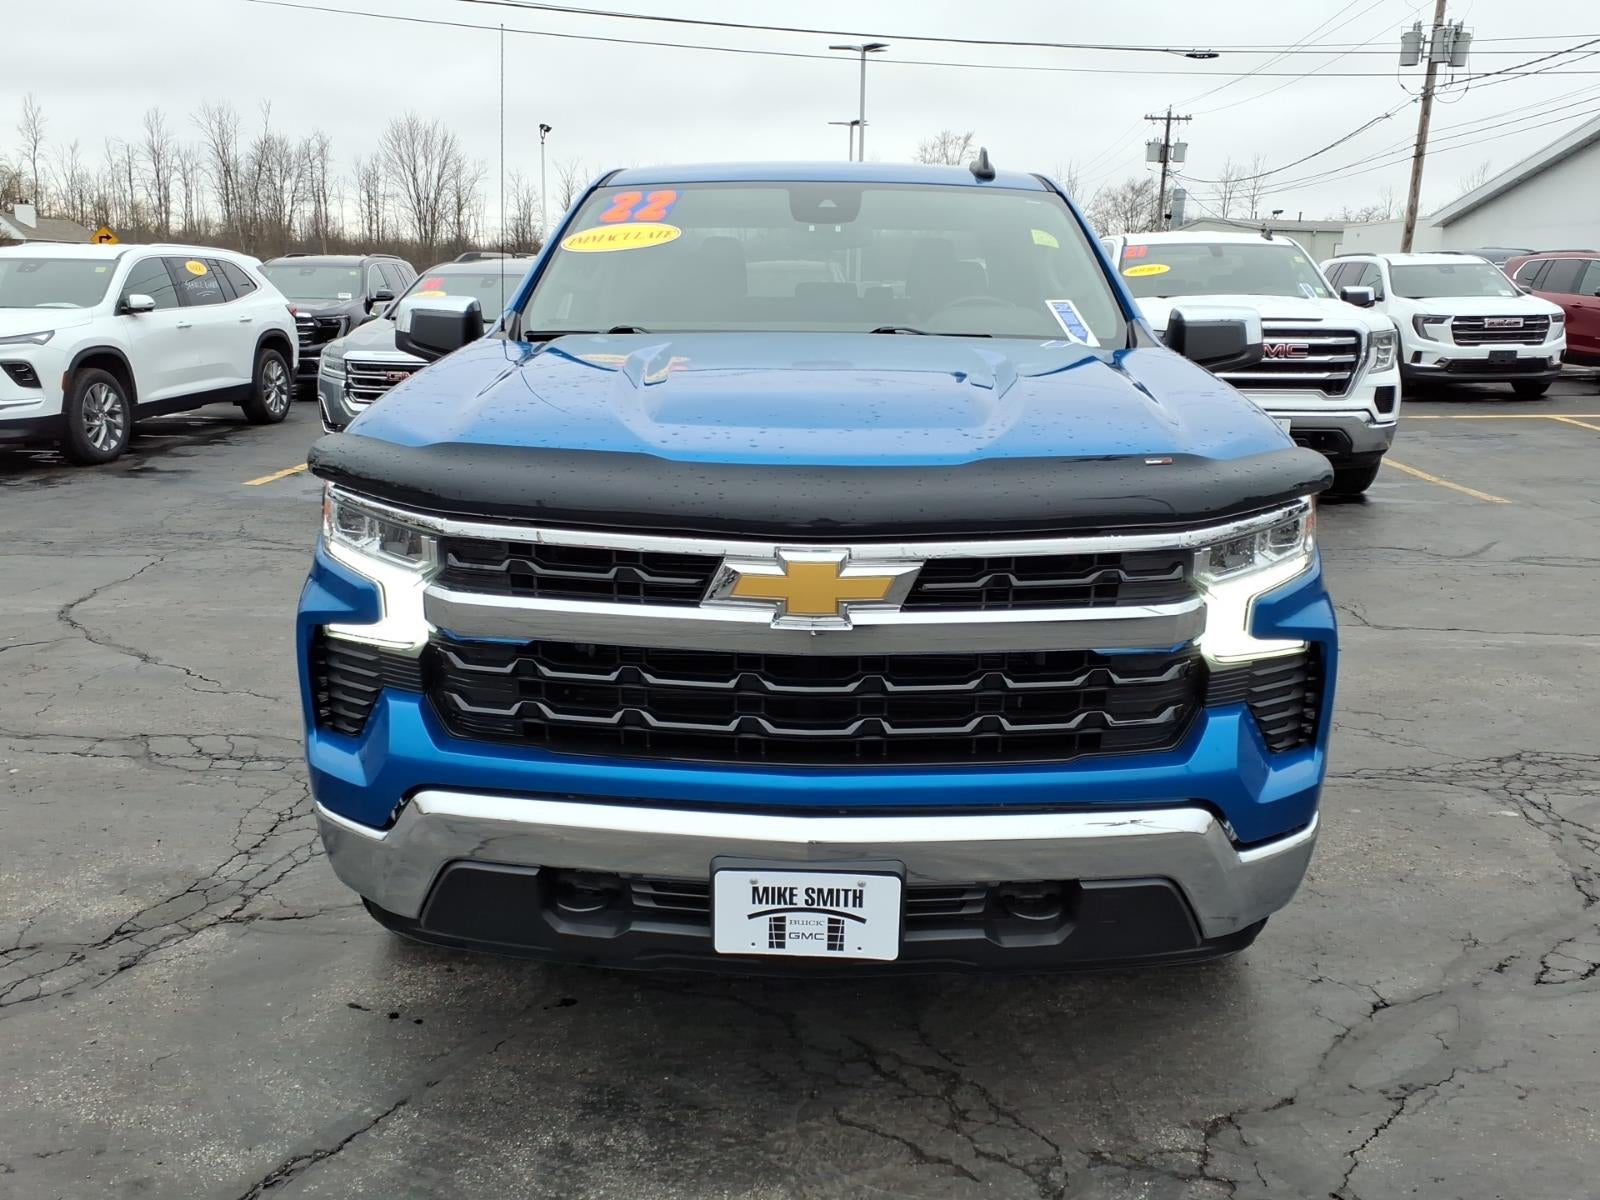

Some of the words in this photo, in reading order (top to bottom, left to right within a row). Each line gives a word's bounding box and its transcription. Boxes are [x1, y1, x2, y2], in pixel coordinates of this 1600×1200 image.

[599, 190, 677, 223] 22
[1262, 343, 1309, 358] MC
[751, 886, 798, 906] MIKE
[804, 887, 864, 909] SMITH
[789, 919, 825, 927] BUICK
[788, 932, 825, 941] GMC
